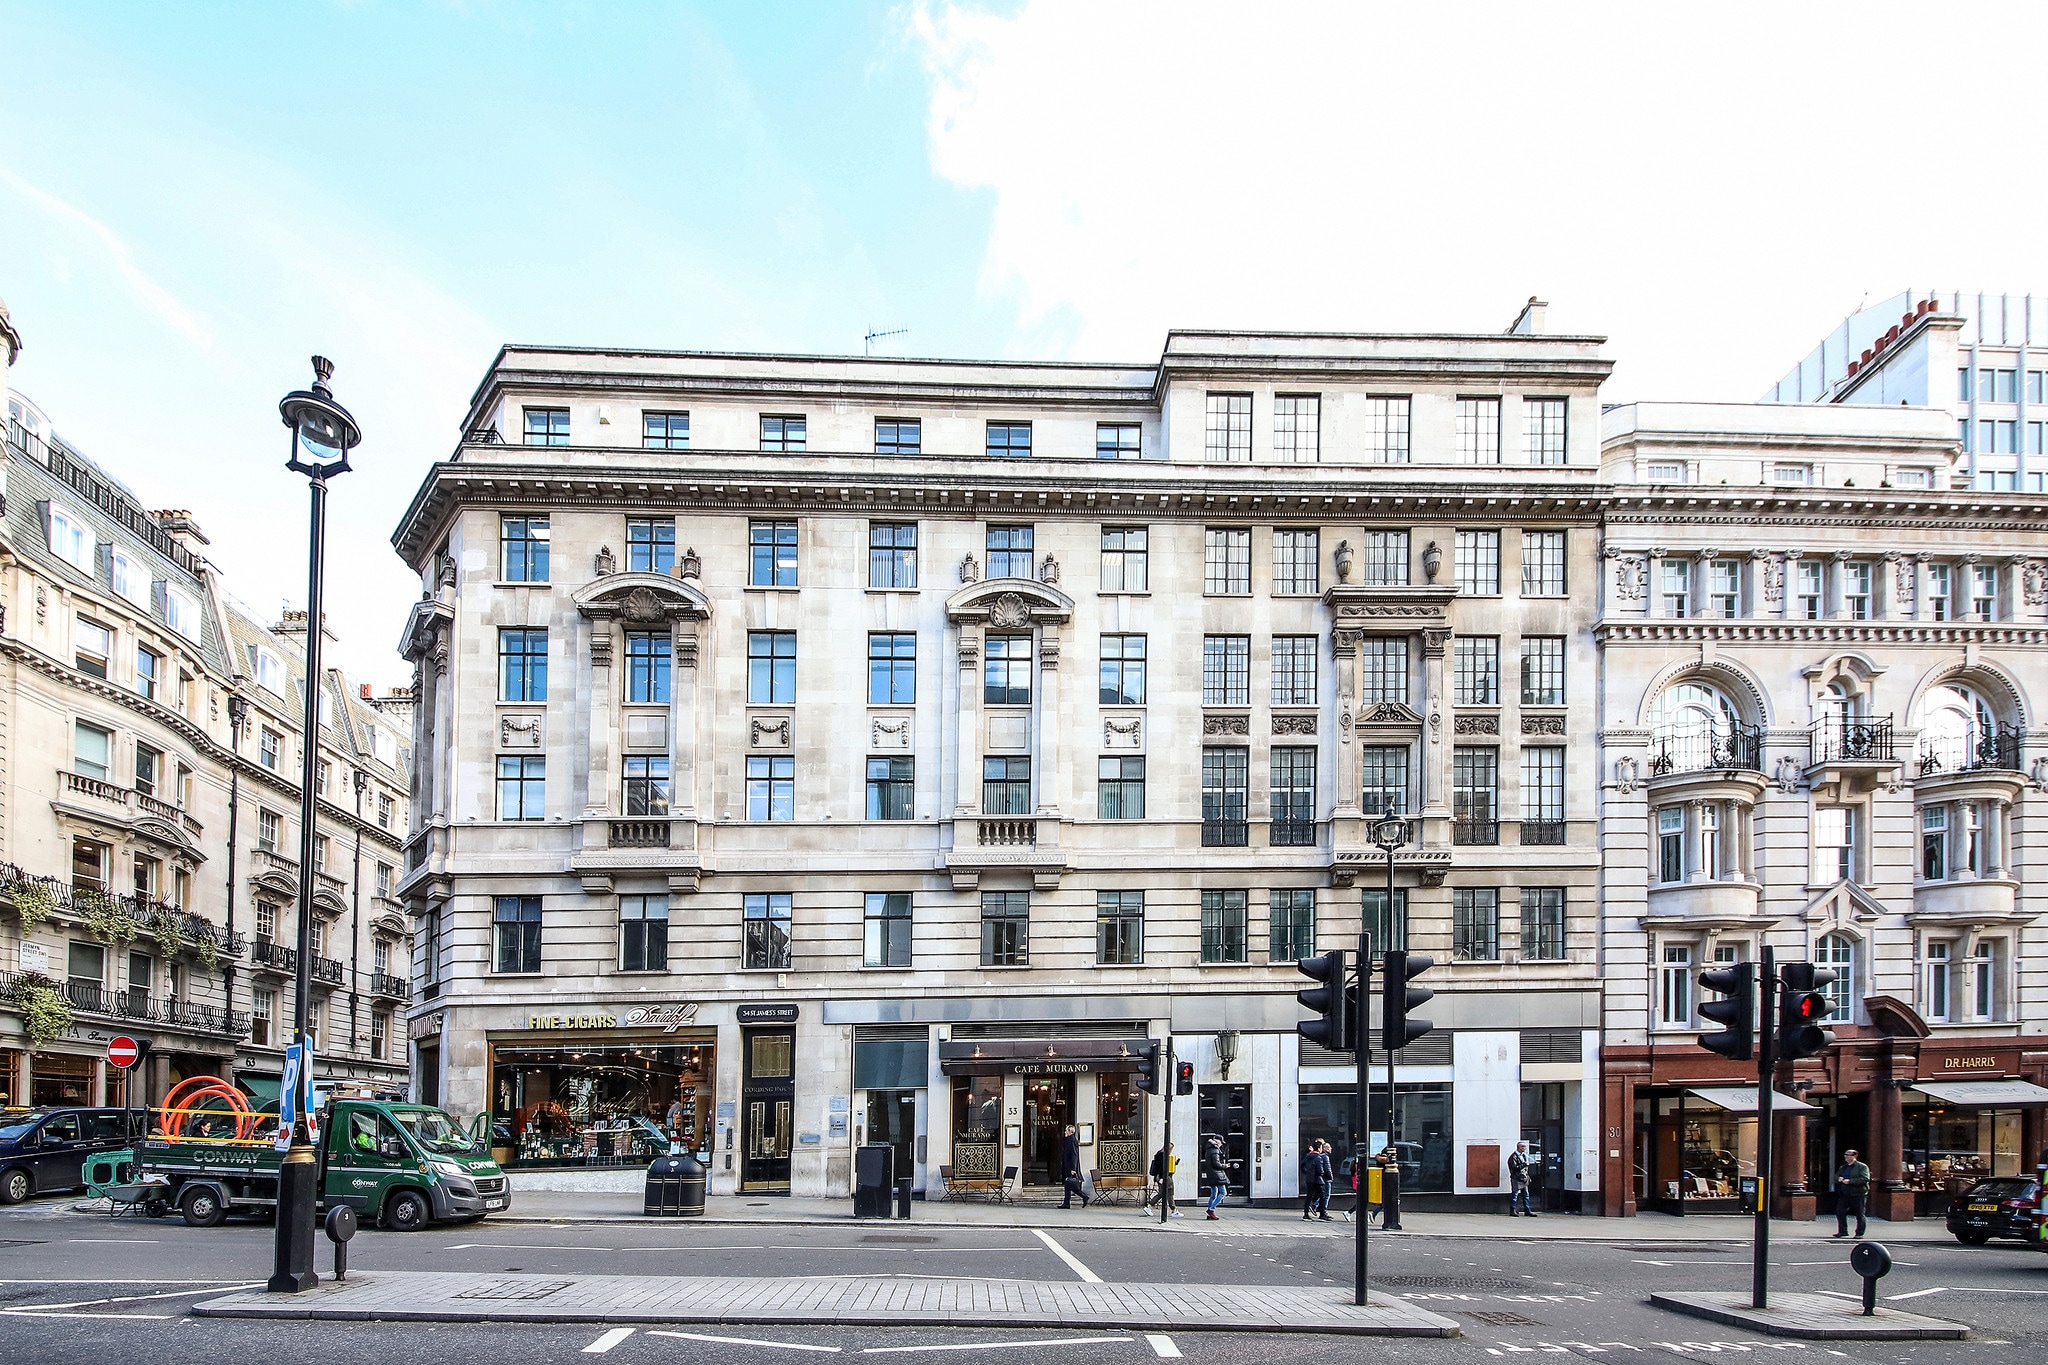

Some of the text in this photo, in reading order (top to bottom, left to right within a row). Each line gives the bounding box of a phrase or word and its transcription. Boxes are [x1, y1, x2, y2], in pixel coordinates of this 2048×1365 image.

[529, 1014, 617, 1029] FINE CIGARS
[624, 1003, 698, 1033] Davidoff
[245, 1057, 256, 1067] 63
[1961, 1057, 1995, 1067] HARRIS
[1014, 1064, 1089, 1073] CAFE MURANO
[1008, 1107, 1018, 1115] 33
[1256, 1116, 1266, 1124] 32
[1609, 1126, 1621, 1138] 30
[193, 1150, 261, 1164] CONWAY
[469, 1161, 498, 1170] CONWAY
